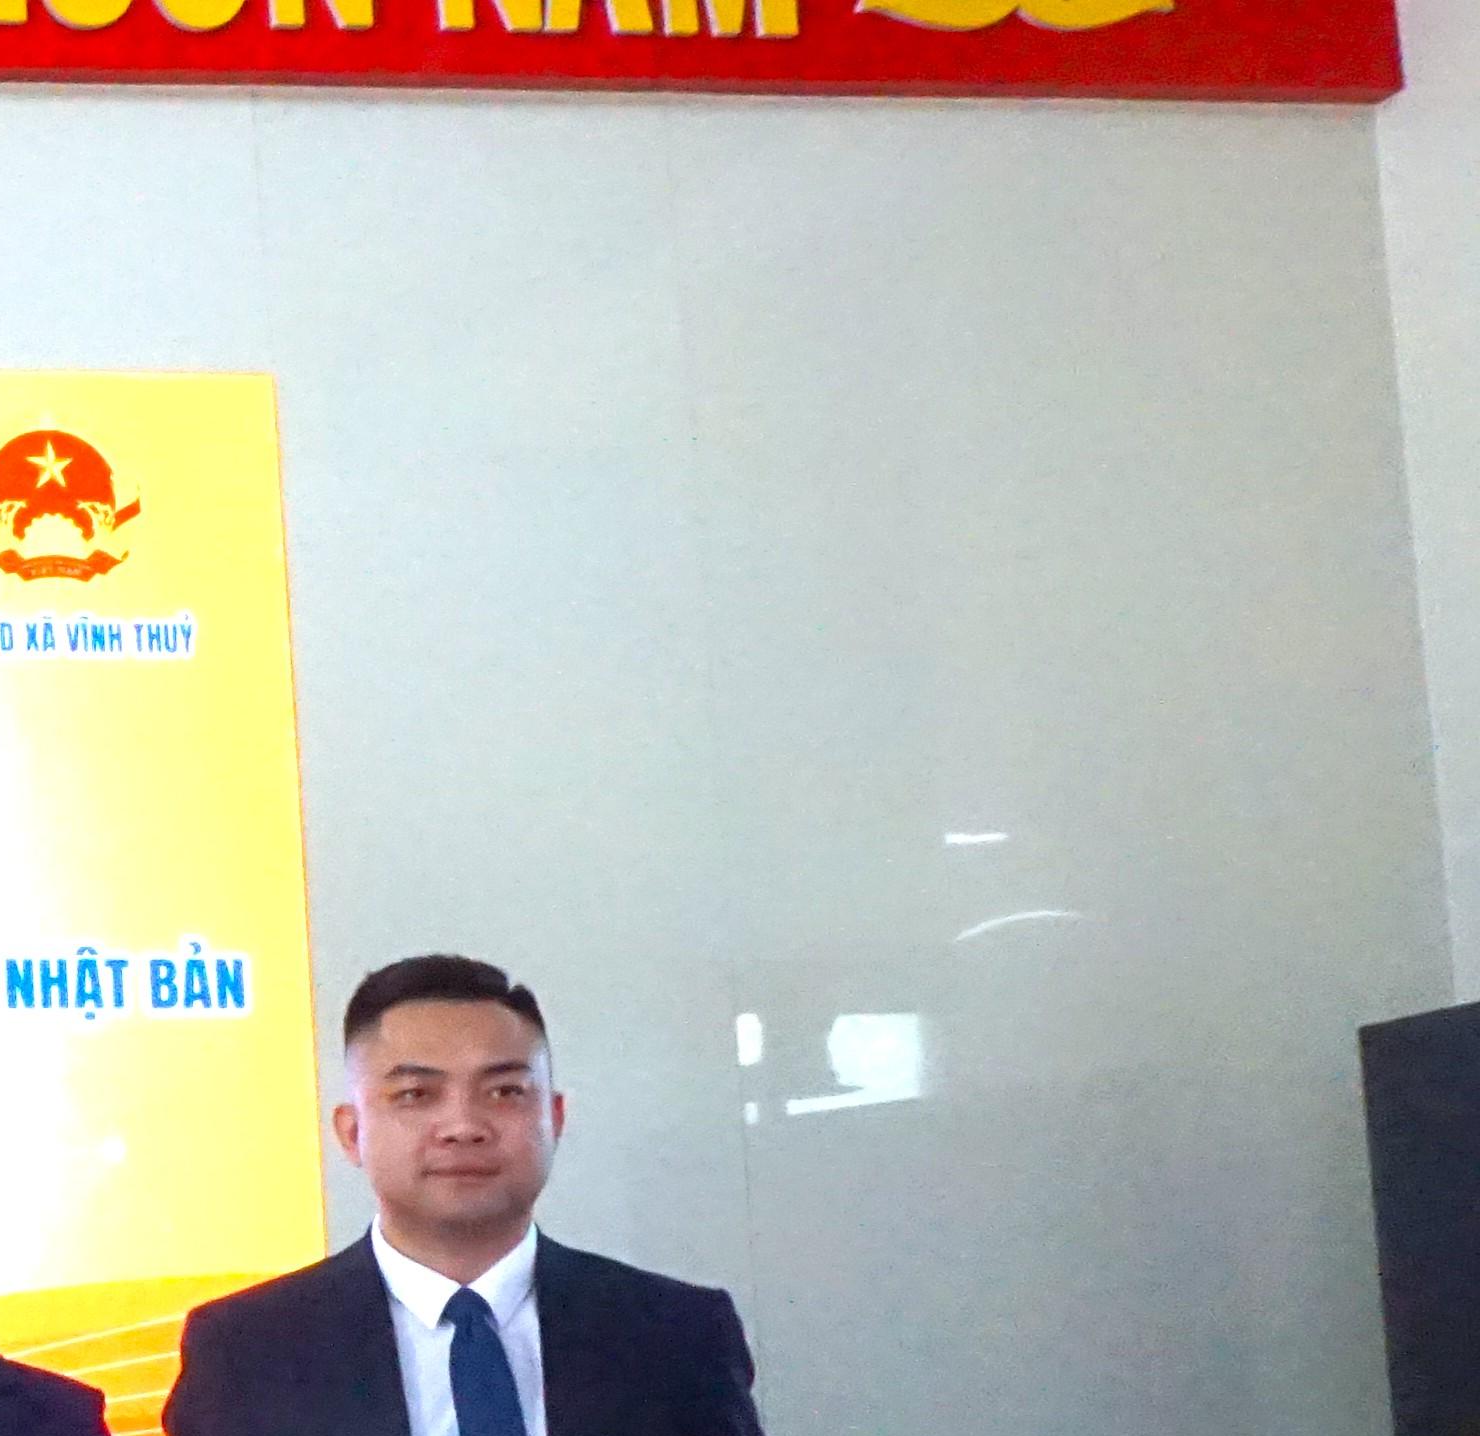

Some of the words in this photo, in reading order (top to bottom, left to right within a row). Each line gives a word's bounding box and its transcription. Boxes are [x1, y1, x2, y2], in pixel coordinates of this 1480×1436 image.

[25, 615, 57, 652] XÃ
[66, 615, 124, 653] VĨNH
[133, 613, 193, 653] THUỶ
[6, 945, 129, 1022] NHẬT
[149, 940, 246, 1011] BẢN
